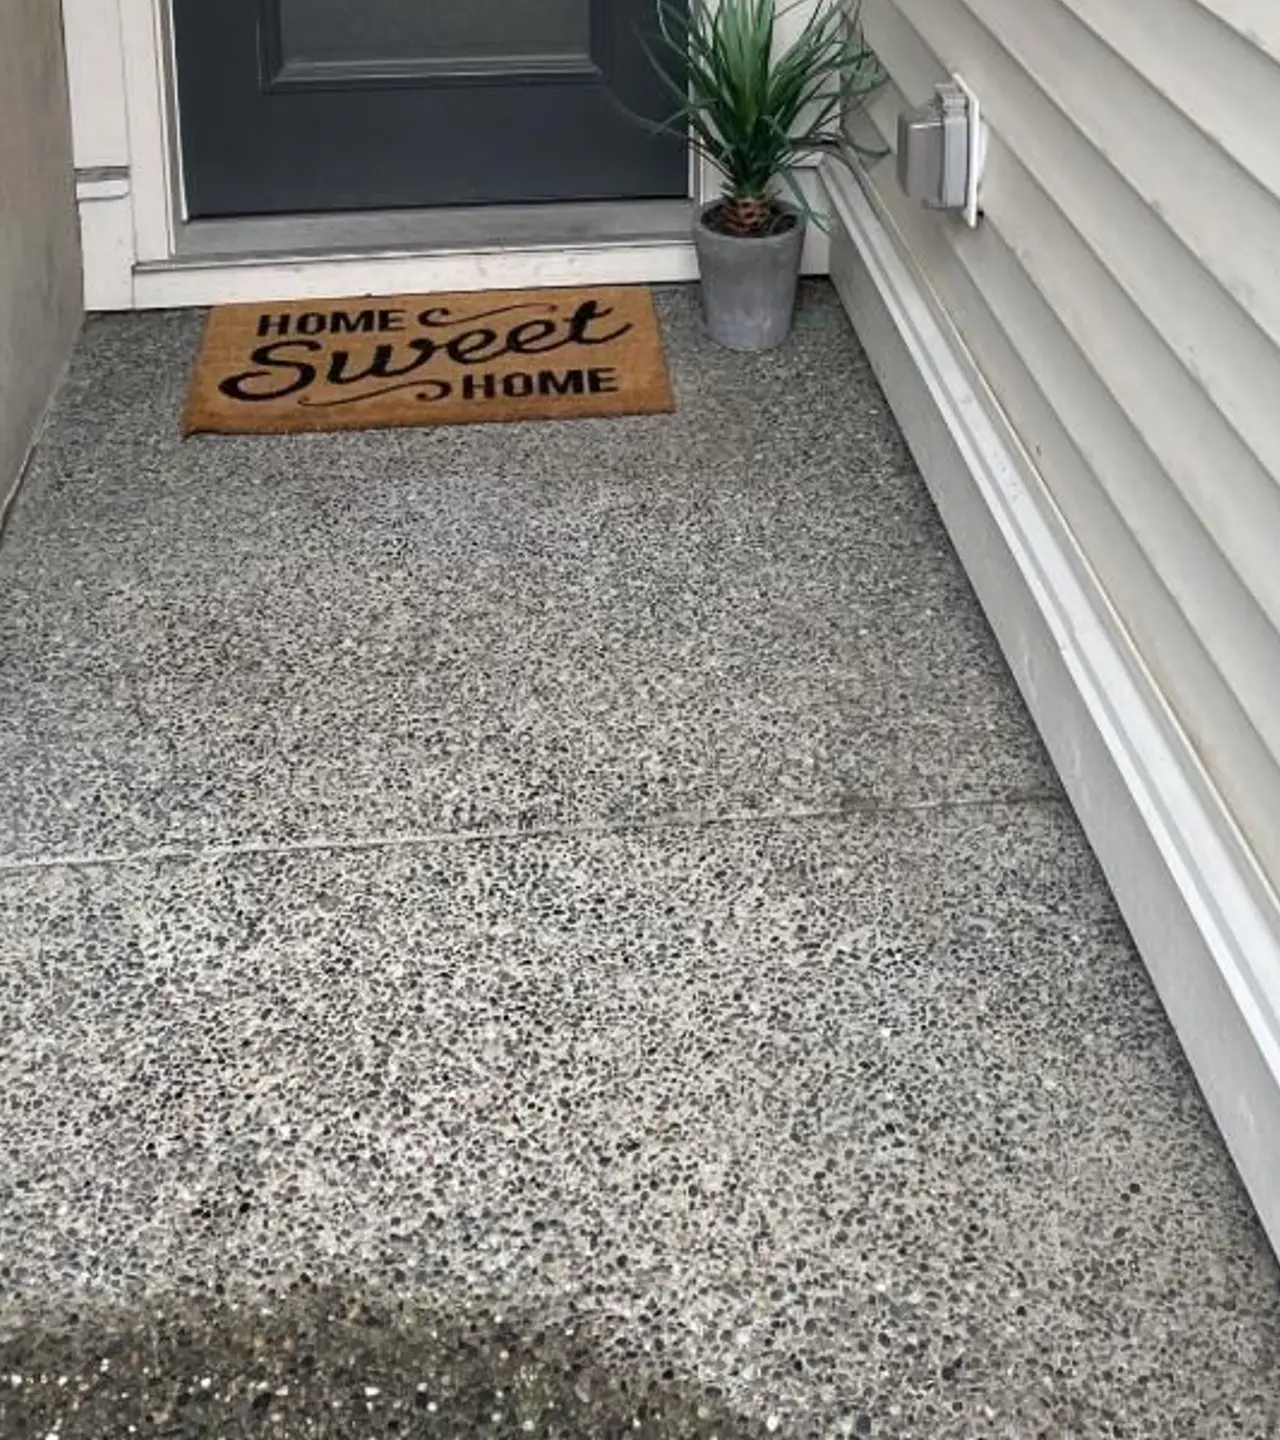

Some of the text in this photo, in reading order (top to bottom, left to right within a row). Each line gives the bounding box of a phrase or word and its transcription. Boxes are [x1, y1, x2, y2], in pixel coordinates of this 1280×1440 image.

[256, 308, 406, 338] HOME
[218, 299, 633, 403] Sweet
[461, 367, 619, 401] HOME
